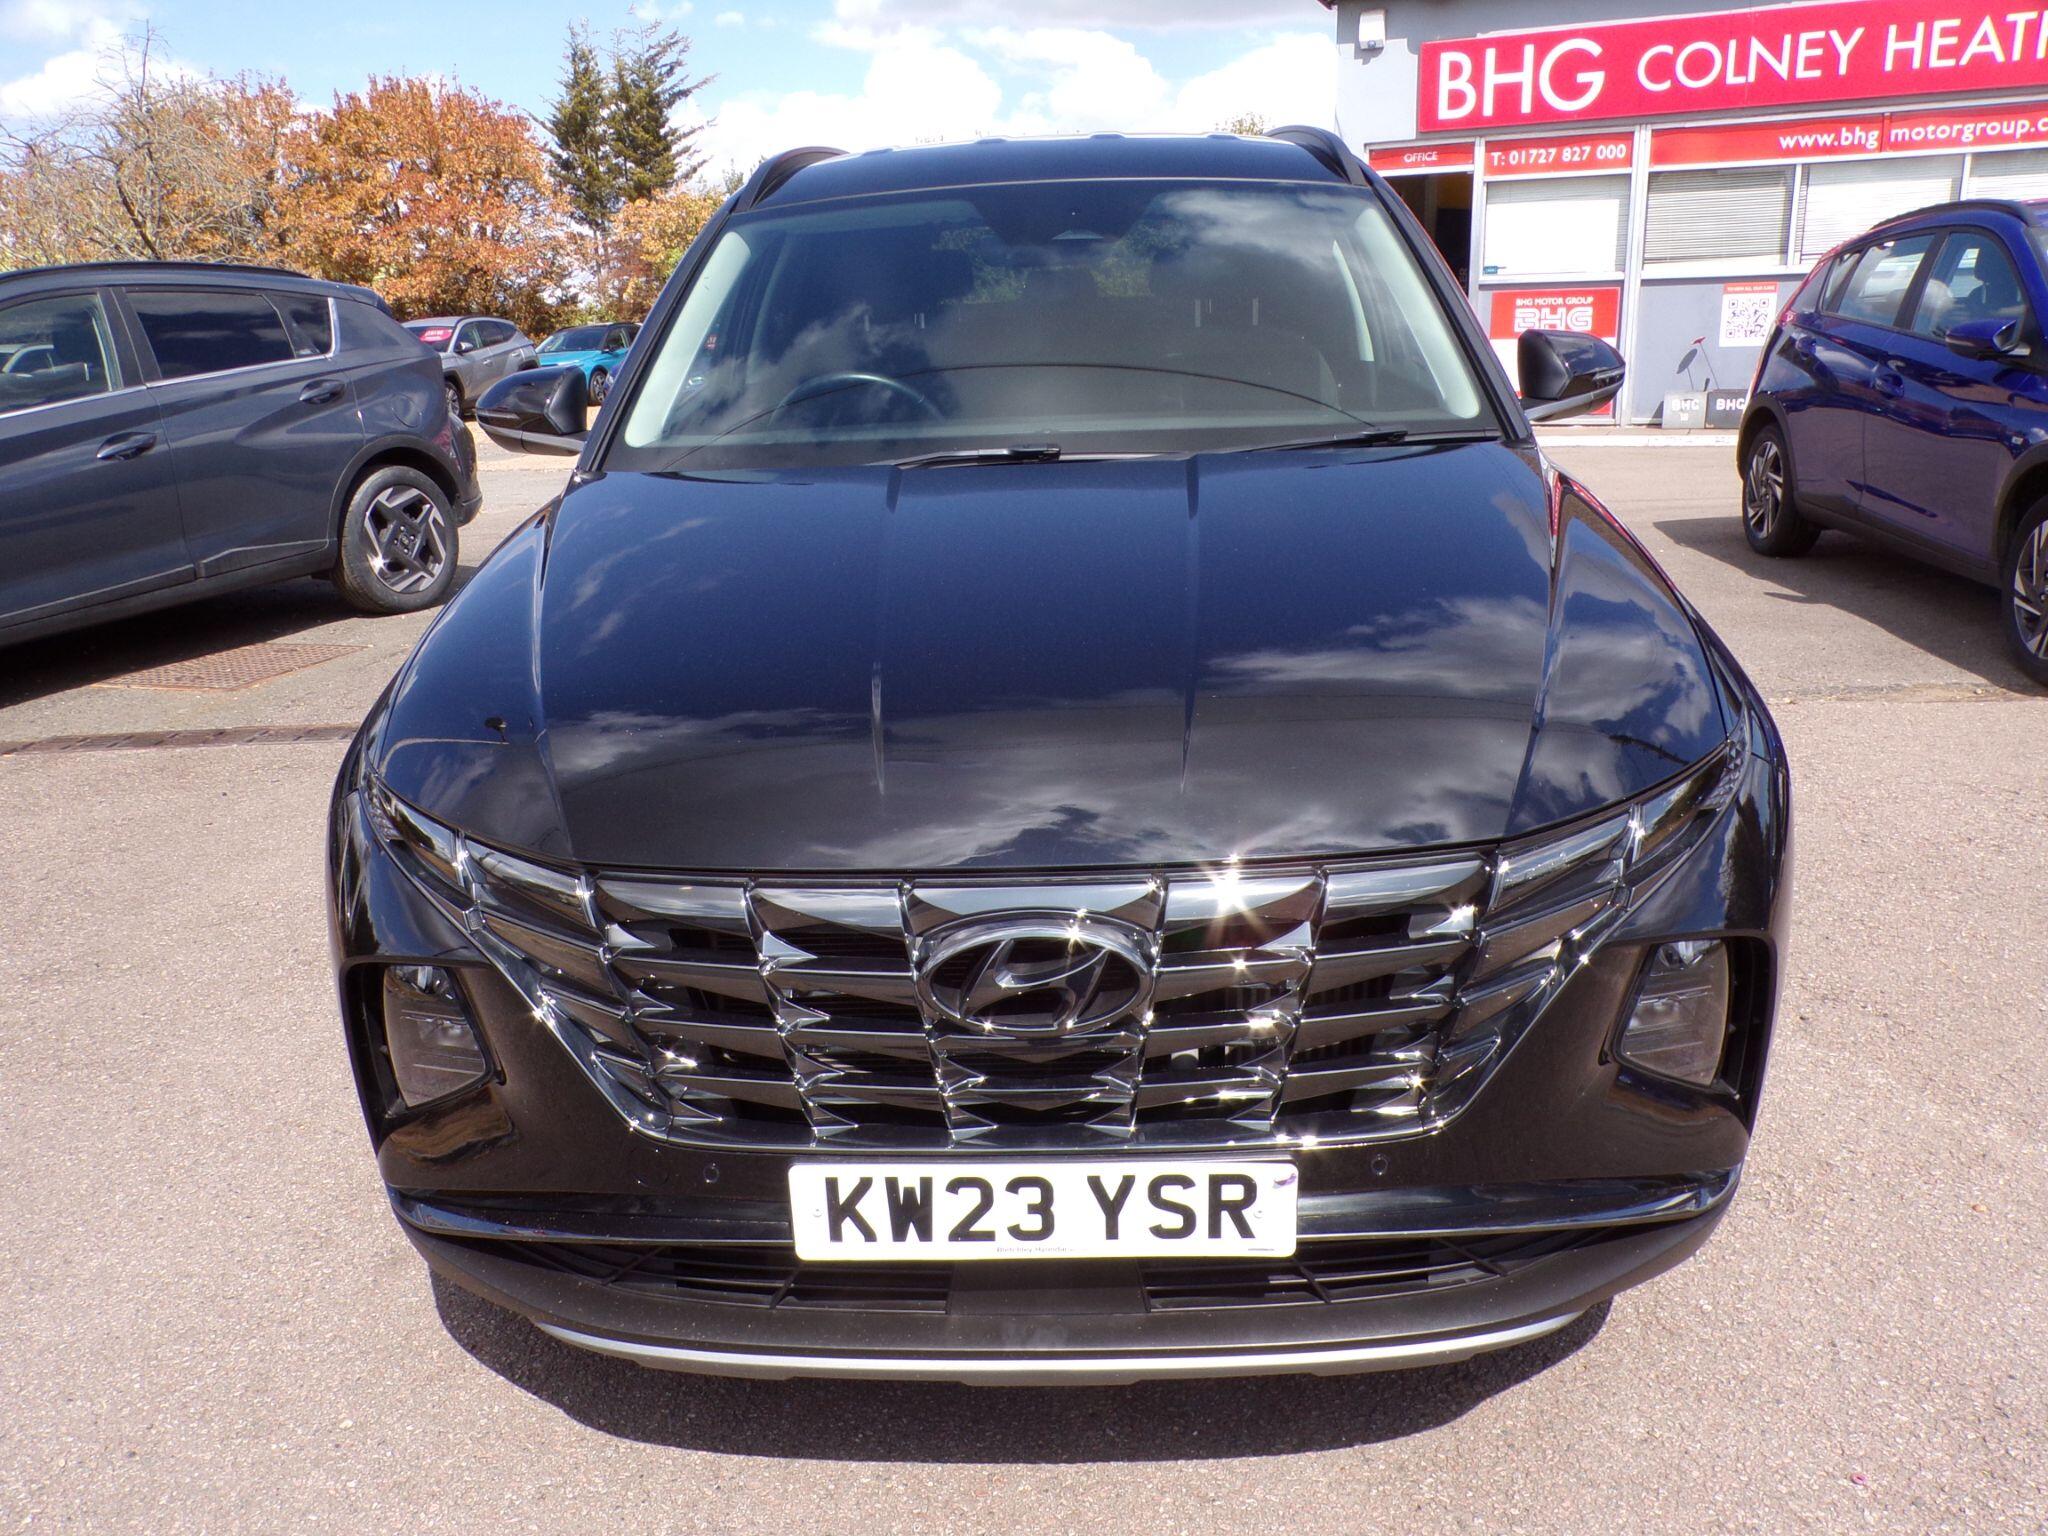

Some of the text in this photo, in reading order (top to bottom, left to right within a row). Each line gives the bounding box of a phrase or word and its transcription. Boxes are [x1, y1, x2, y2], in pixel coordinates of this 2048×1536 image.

[1437, 38, 1605, 120] BHG
[1637, 27, 1864, 92] COLNEY
[1779, 126, 1880, 149] www.bhg
[1403, 151, 1438, 163] OFFICE
[1491, 144, 1627, 167] T: 01727 827 000
[1515, 296, 1594, 306] BHG MOTOR GROUP
[1514, 306, 1594, 333] BHG
[825, 1174, 1258, 1243] KW23 YSR
